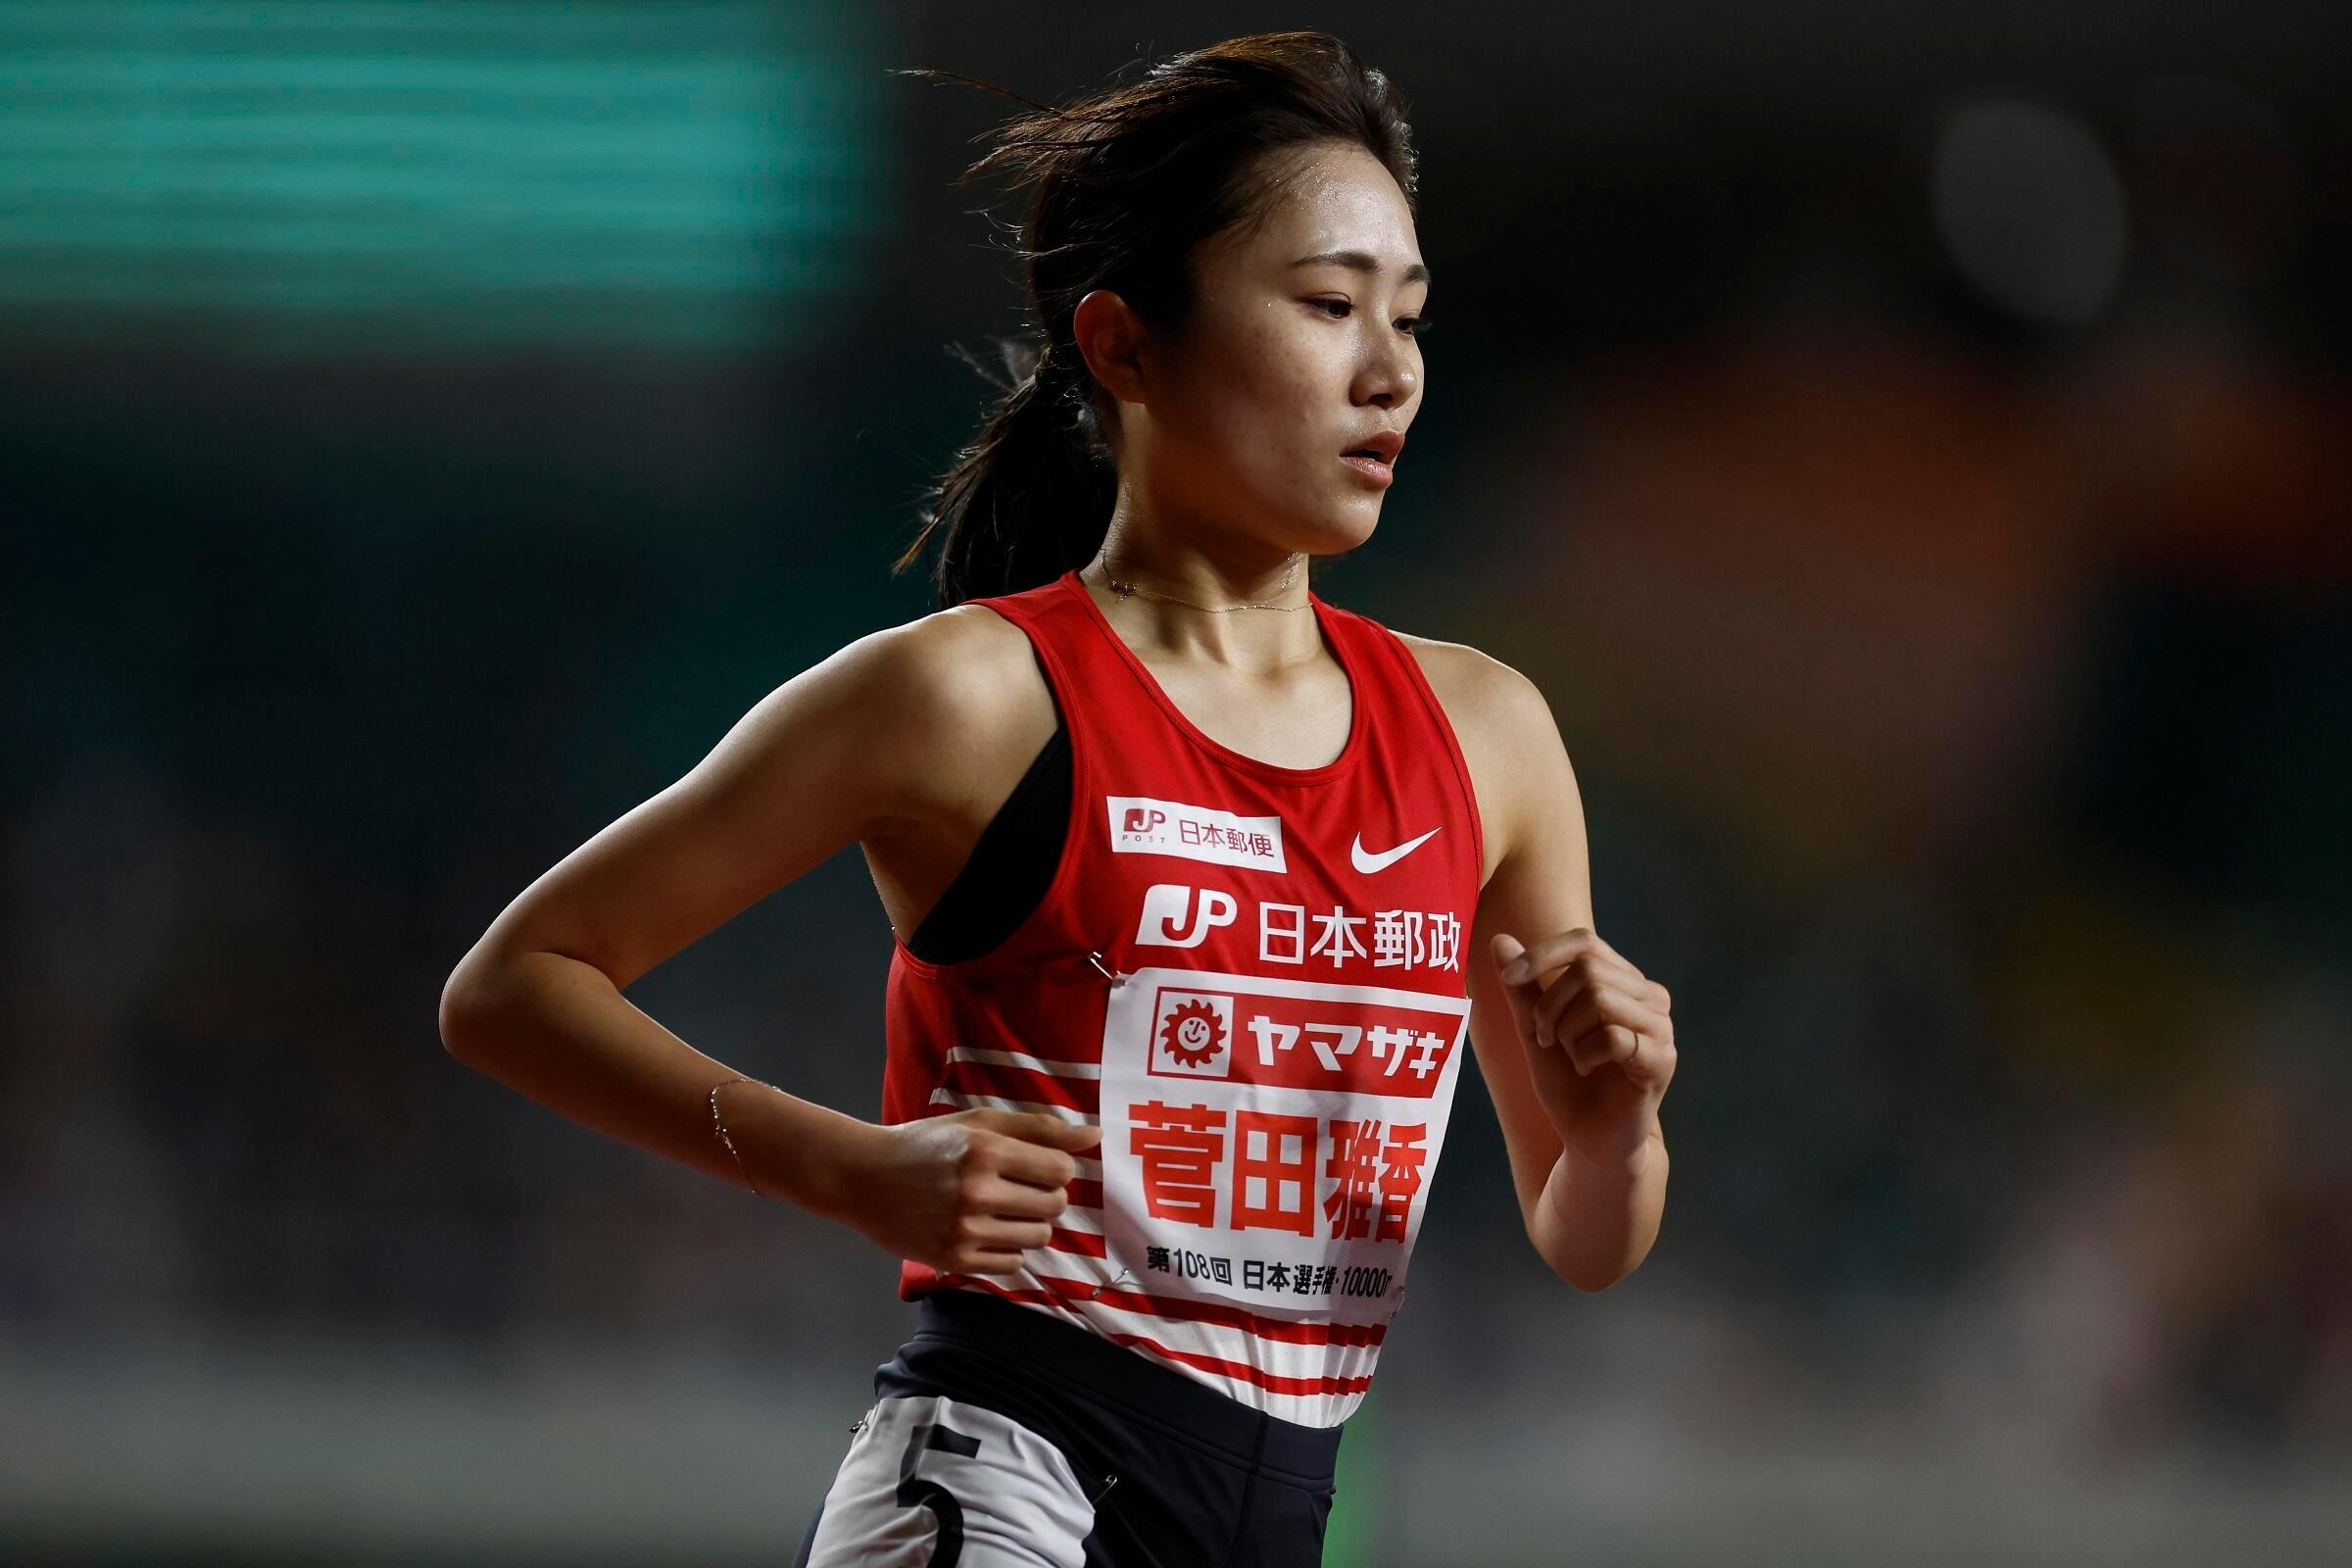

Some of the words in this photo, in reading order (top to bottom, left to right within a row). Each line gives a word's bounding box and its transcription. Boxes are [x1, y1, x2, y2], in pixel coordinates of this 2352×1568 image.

[1122, 835, 1166, 844] POST
[1179, 820, 1274, 858] 日本郵便
[1135, 884, 1238, 948] JP
[1259, 902, 1461, 973] 日本郵政
[1248, 1014, 1445, 1079] ヤマザキ
[1128, 1100, 1427, 1244] 菅田雅香
[1147, 1246, 1233, 1286] 第108回
[897, 1424, 982, 1568] 5
